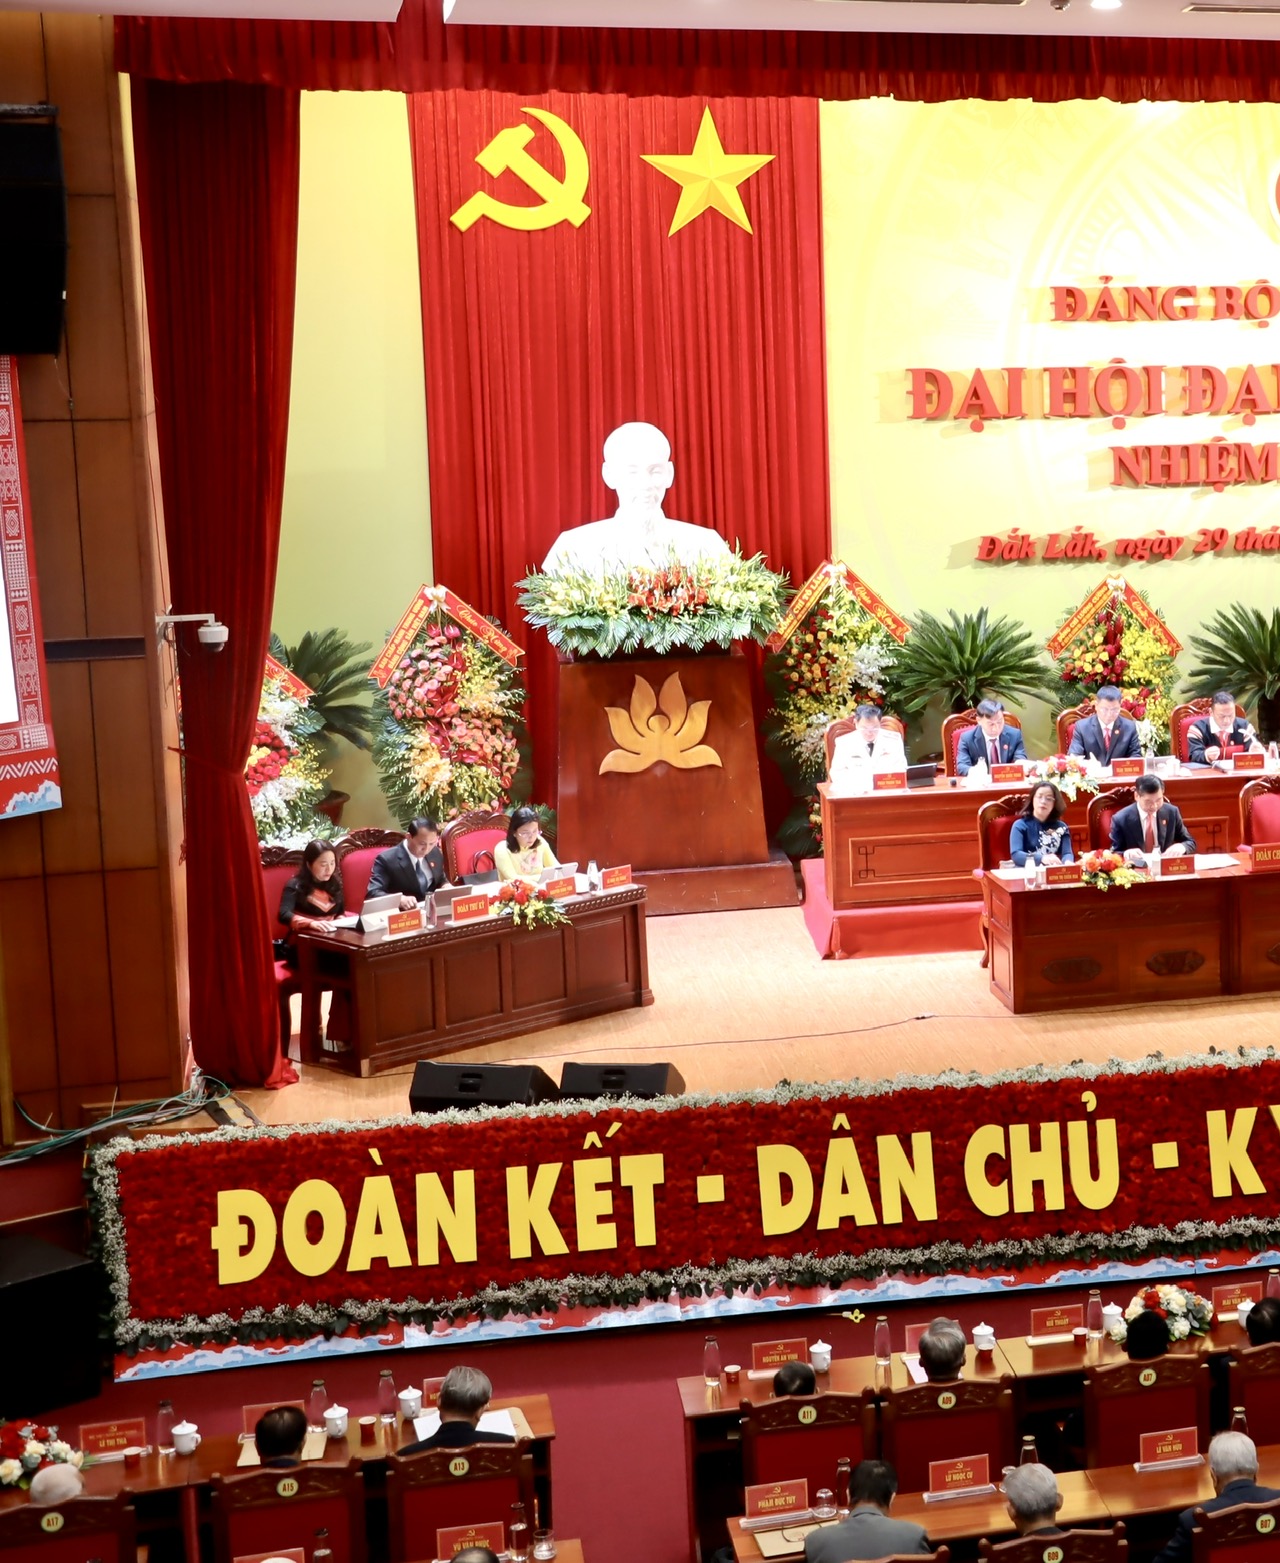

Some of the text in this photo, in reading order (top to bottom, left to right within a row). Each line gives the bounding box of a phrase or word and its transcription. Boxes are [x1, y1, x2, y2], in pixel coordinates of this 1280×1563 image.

[1050, 275, 1198, 322] ĐẢNG
[905, 365, 1027, 433] ĐẠI
[1042, 358, 1167, 429] HỘI
[1109, 437, 1278, 492] NHIỆM
[976, 528, 1036, 561] Đắk
[1042, 525, 1107, 562] Lắk,
[1114, 529, 1184, 561] ngày
[1193, 528, 1228, 554] 29
[1256, 848, 1271, 861] ĐOÀN
[211, 1148, 477, 1285] ĐOÀN
[506, 1121, 665, 1259] KẾT
[757, 1113, 937, 1236] DÂN
[964, 1090, 1120, 1217] CHỦ
[802, 1410, 812, 1420] A11
[453, 1461, 464, 1471] A13
[282, 1482, 294, 1492] A15
[47, 1517, 59, 1527] A17
